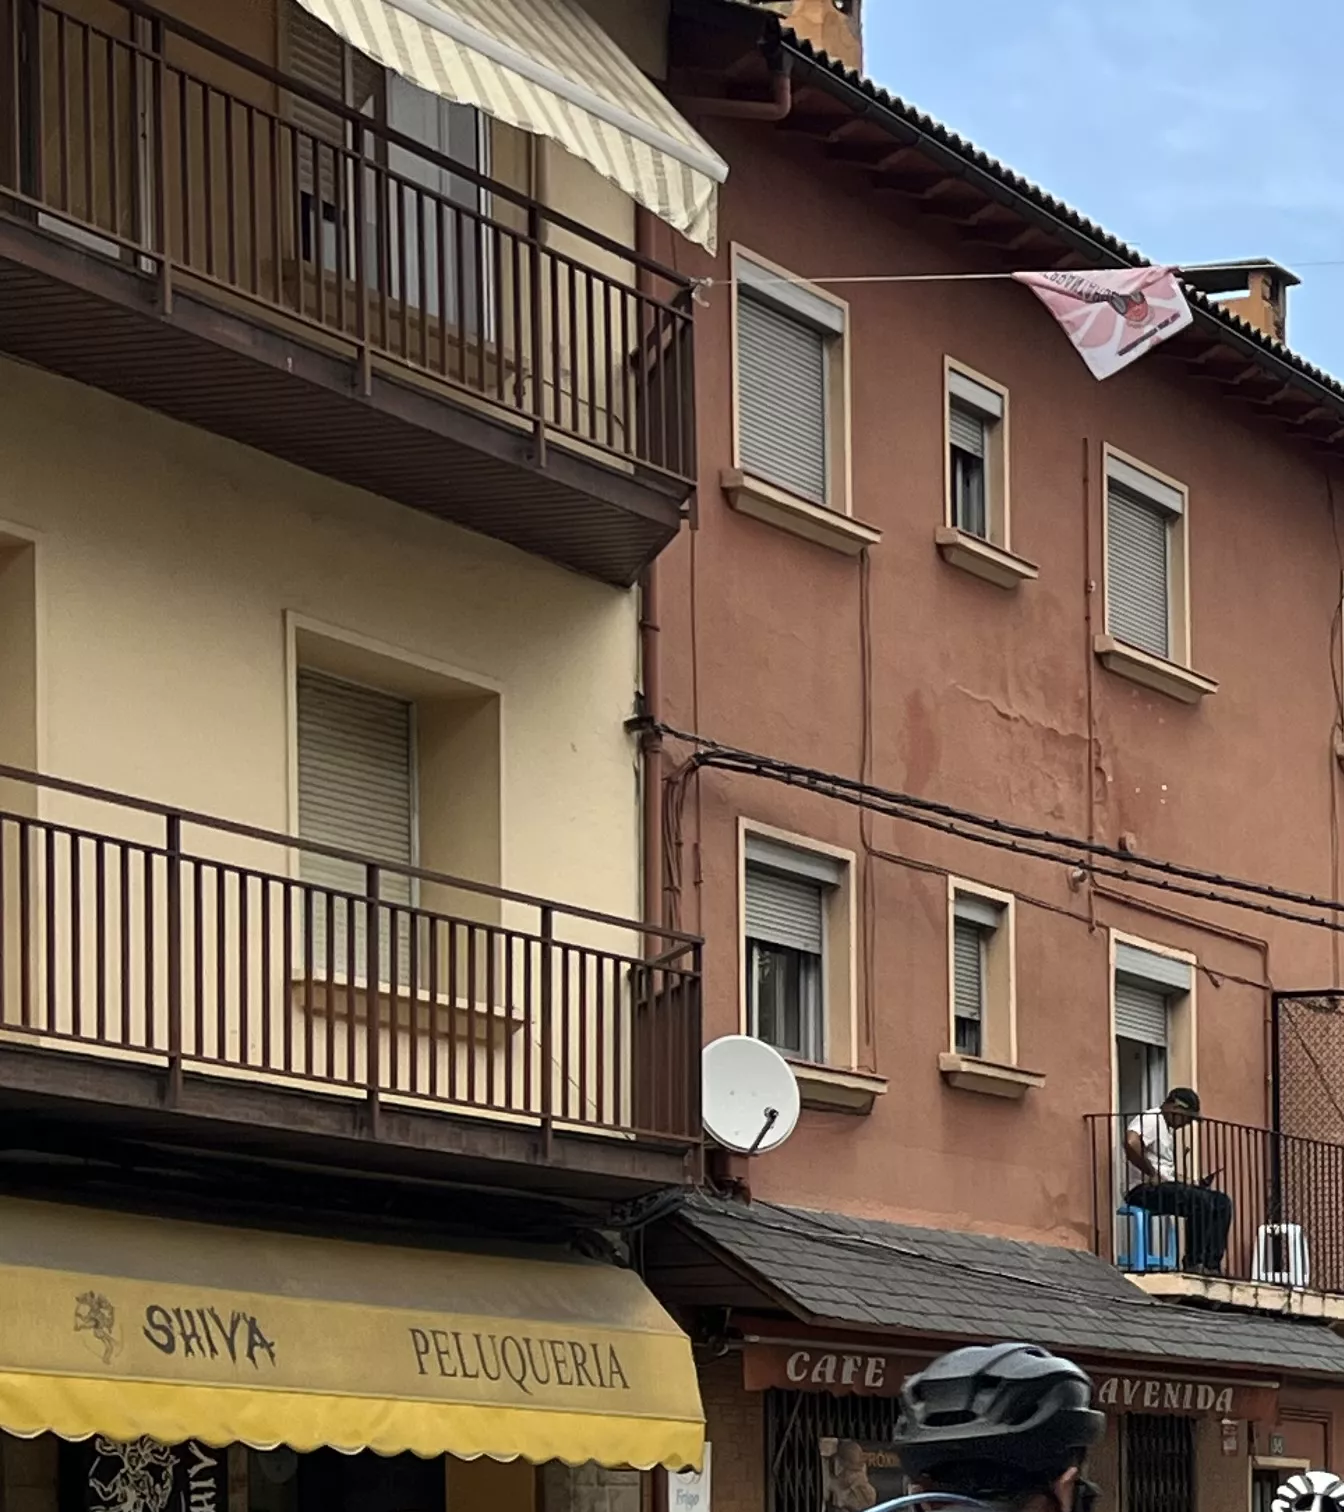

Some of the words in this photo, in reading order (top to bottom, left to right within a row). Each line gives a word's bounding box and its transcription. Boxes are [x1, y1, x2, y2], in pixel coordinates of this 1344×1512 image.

[143, 1304, 277, 1369] SHIVA
[408, 1328, 631, 1395] PELUQUERIA
[786, 1350, 886, 1388] CAFE
[1100, 1377, 1235, 1413] AVENIDA
